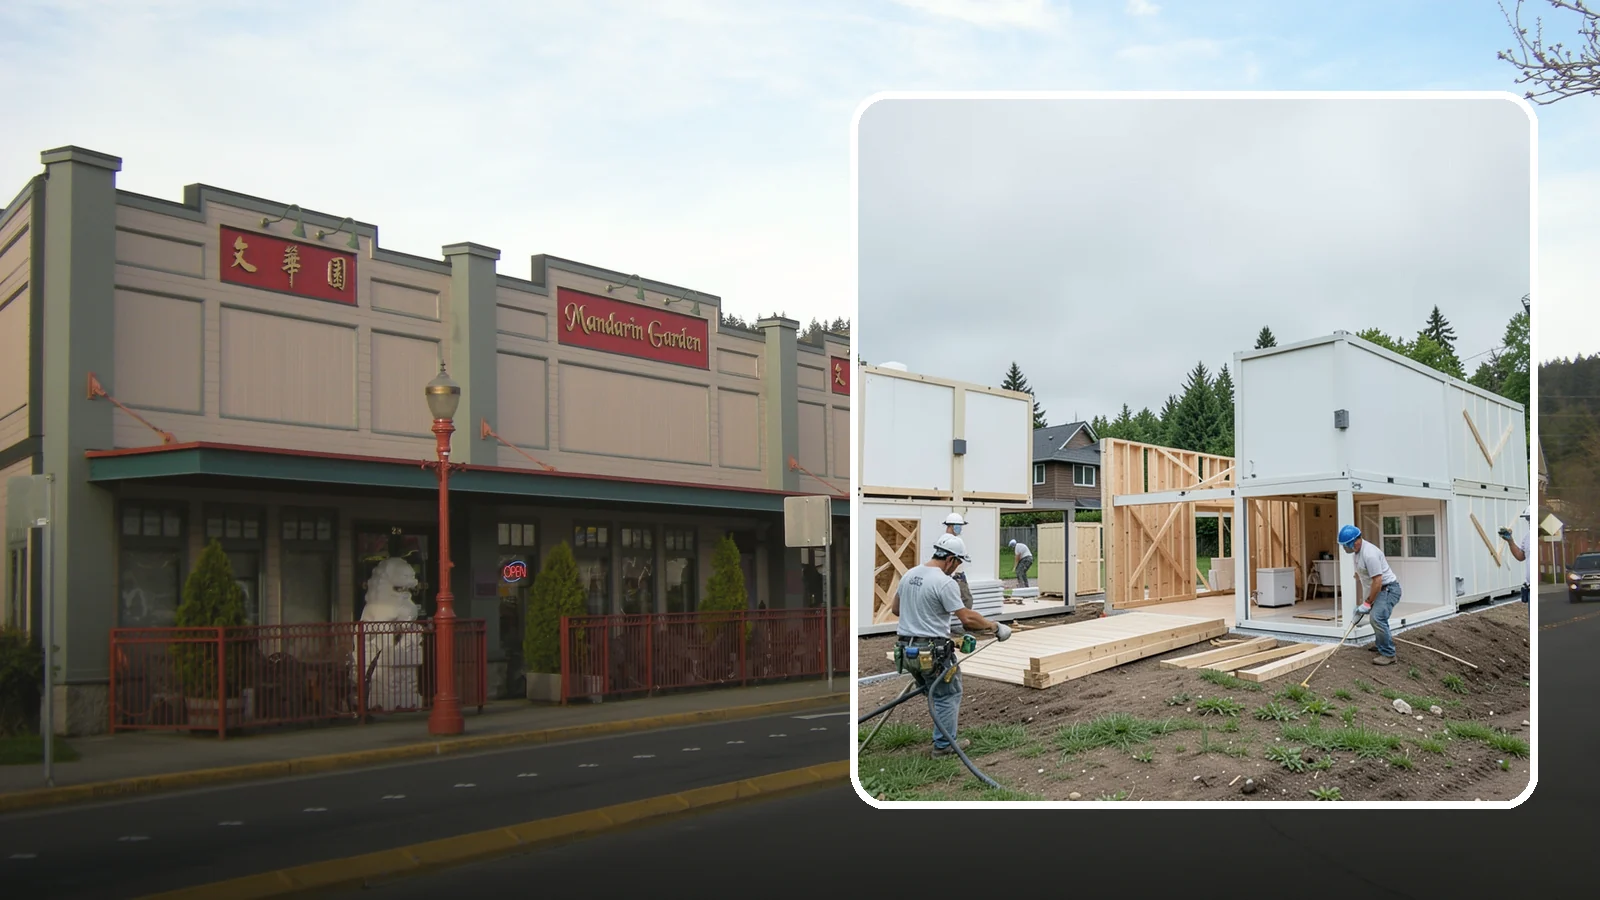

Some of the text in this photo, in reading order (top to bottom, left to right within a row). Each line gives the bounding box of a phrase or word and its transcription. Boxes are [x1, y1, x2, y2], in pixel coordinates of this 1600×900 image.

[230, 235, 346, 291] 文華園
[564, 302, 702, 352] Mandarin Garden
[503, 566, 526, 578] OPEN
